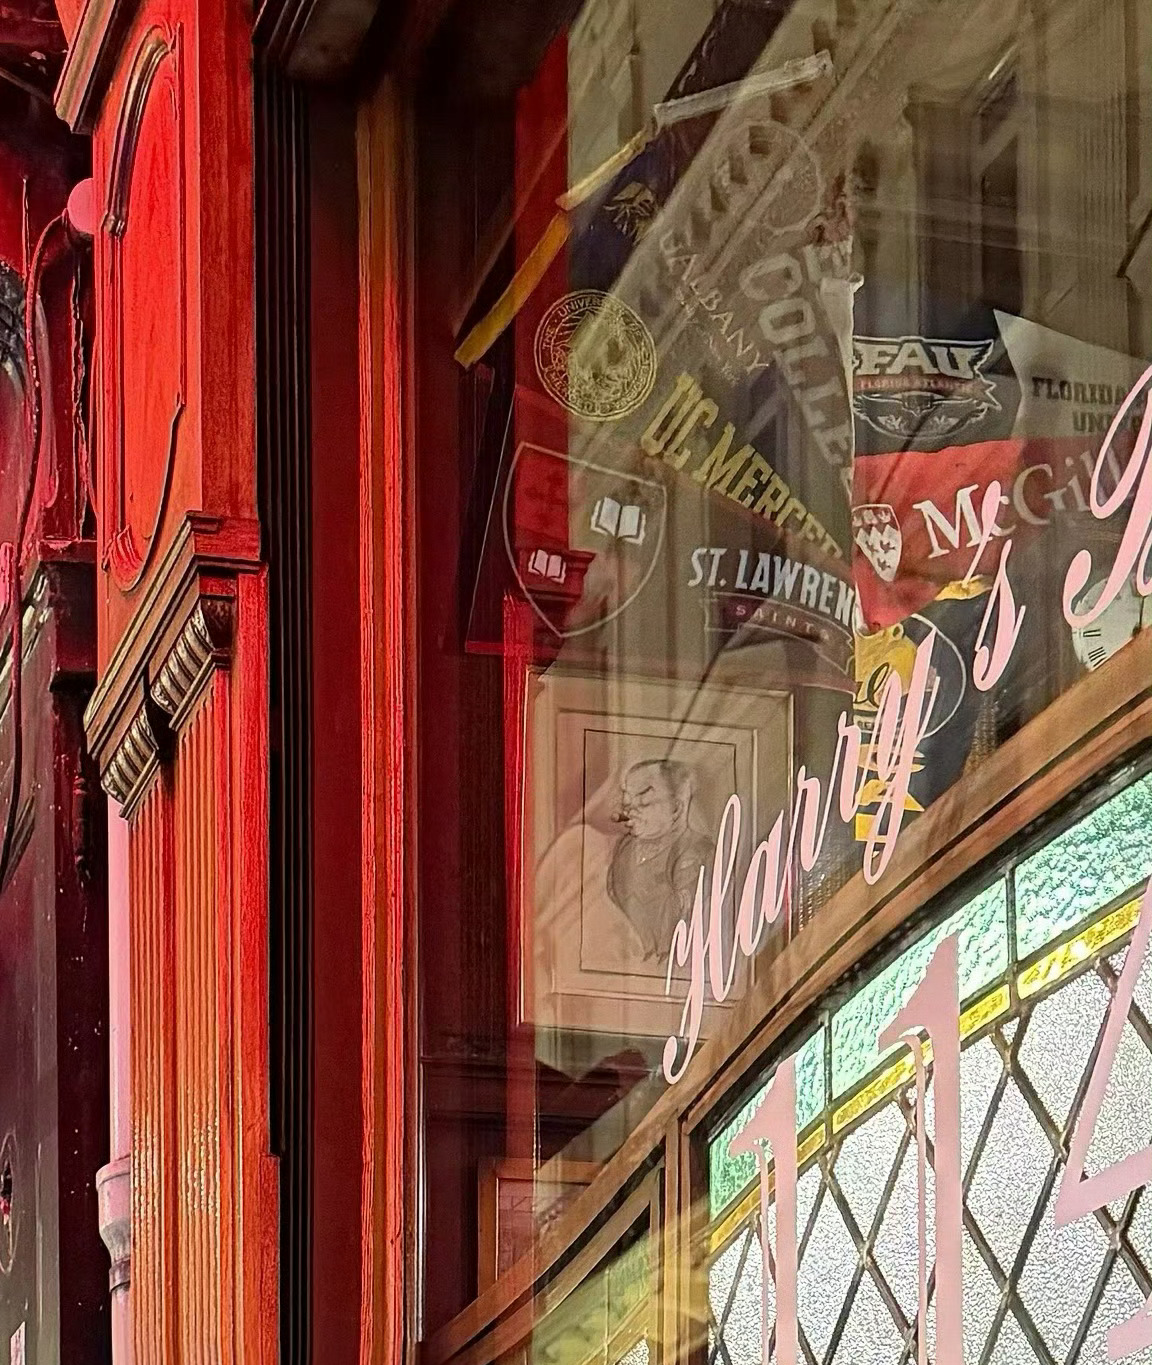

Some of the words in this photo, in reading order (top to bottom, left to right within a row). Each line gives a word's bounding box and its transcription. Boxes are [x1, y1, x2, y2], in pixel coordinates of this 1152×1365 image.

[853, 341, 986, 380] FAU
[641, 371, 719, 471] UC
[687, 547, 728, 587] ST.
[663, 480, 1027, 1086] Harry's
